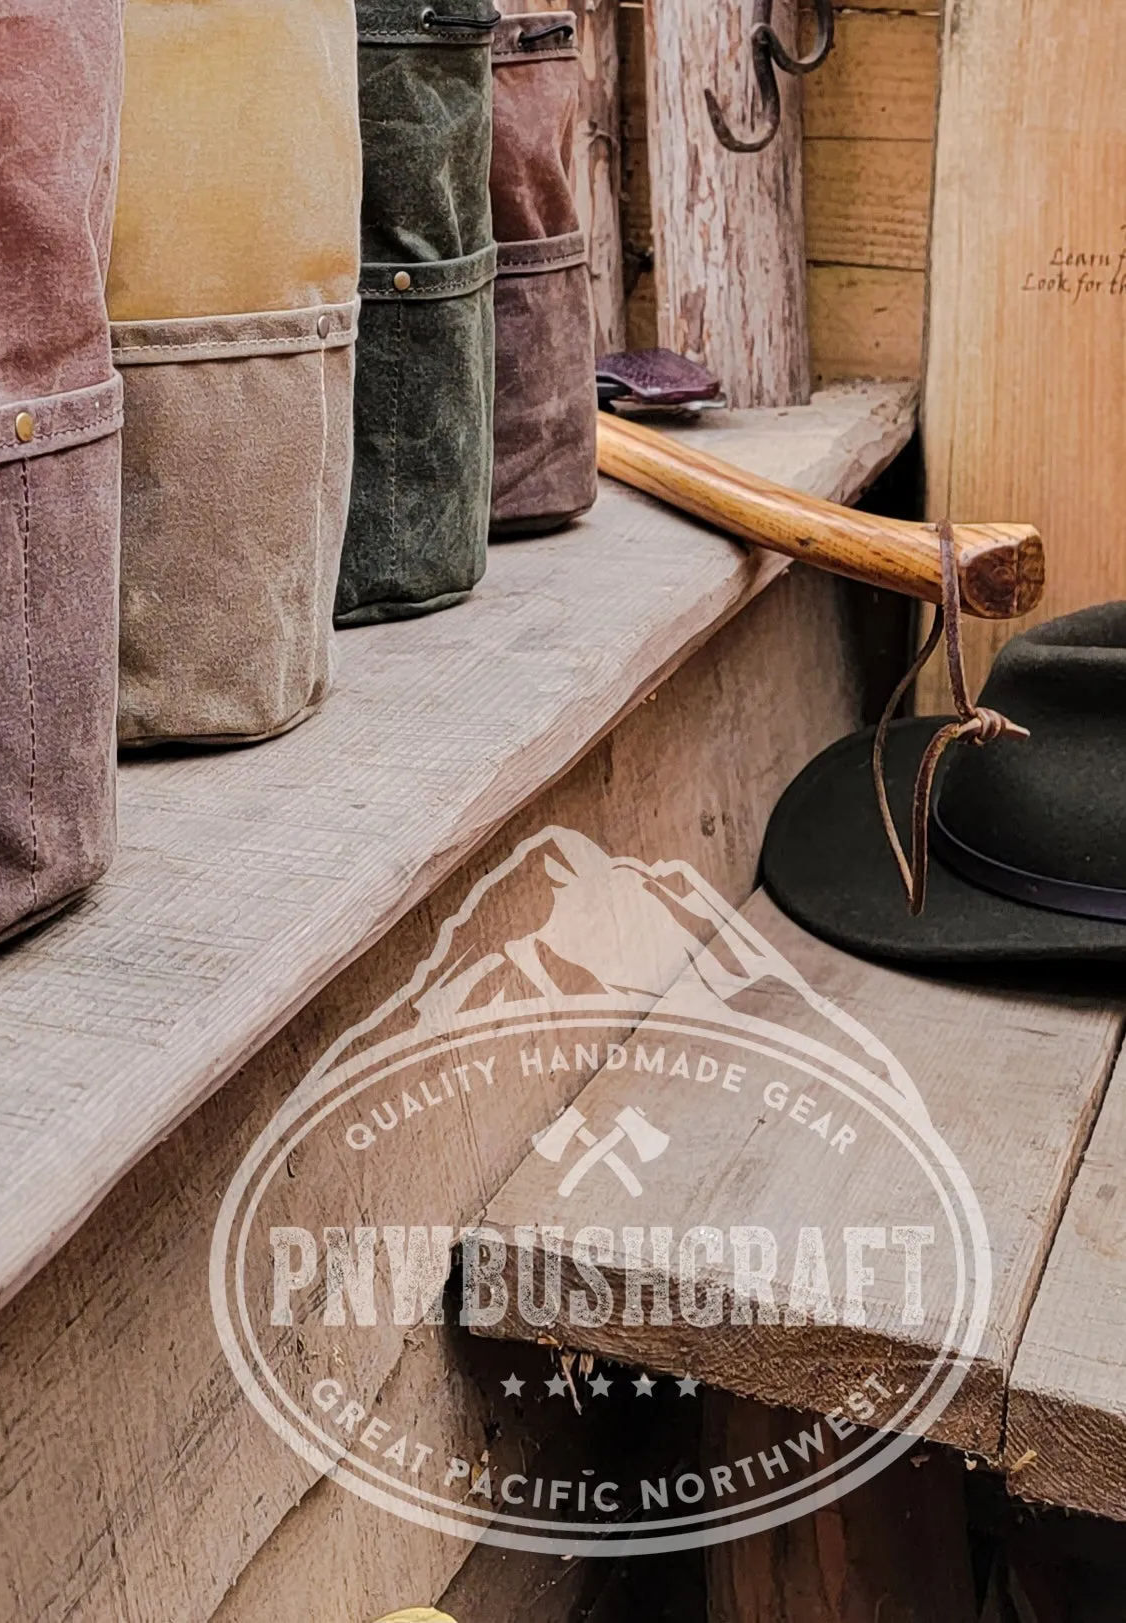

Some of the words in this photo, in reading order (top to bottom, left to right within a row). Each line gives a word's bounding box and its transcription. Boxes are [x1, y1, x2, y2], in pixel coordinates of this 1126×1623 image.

[1049, 247, 1110, 267] Learn
[1021, 269, 1071, 293] Look
[1072, 272, 1101, 305] for
